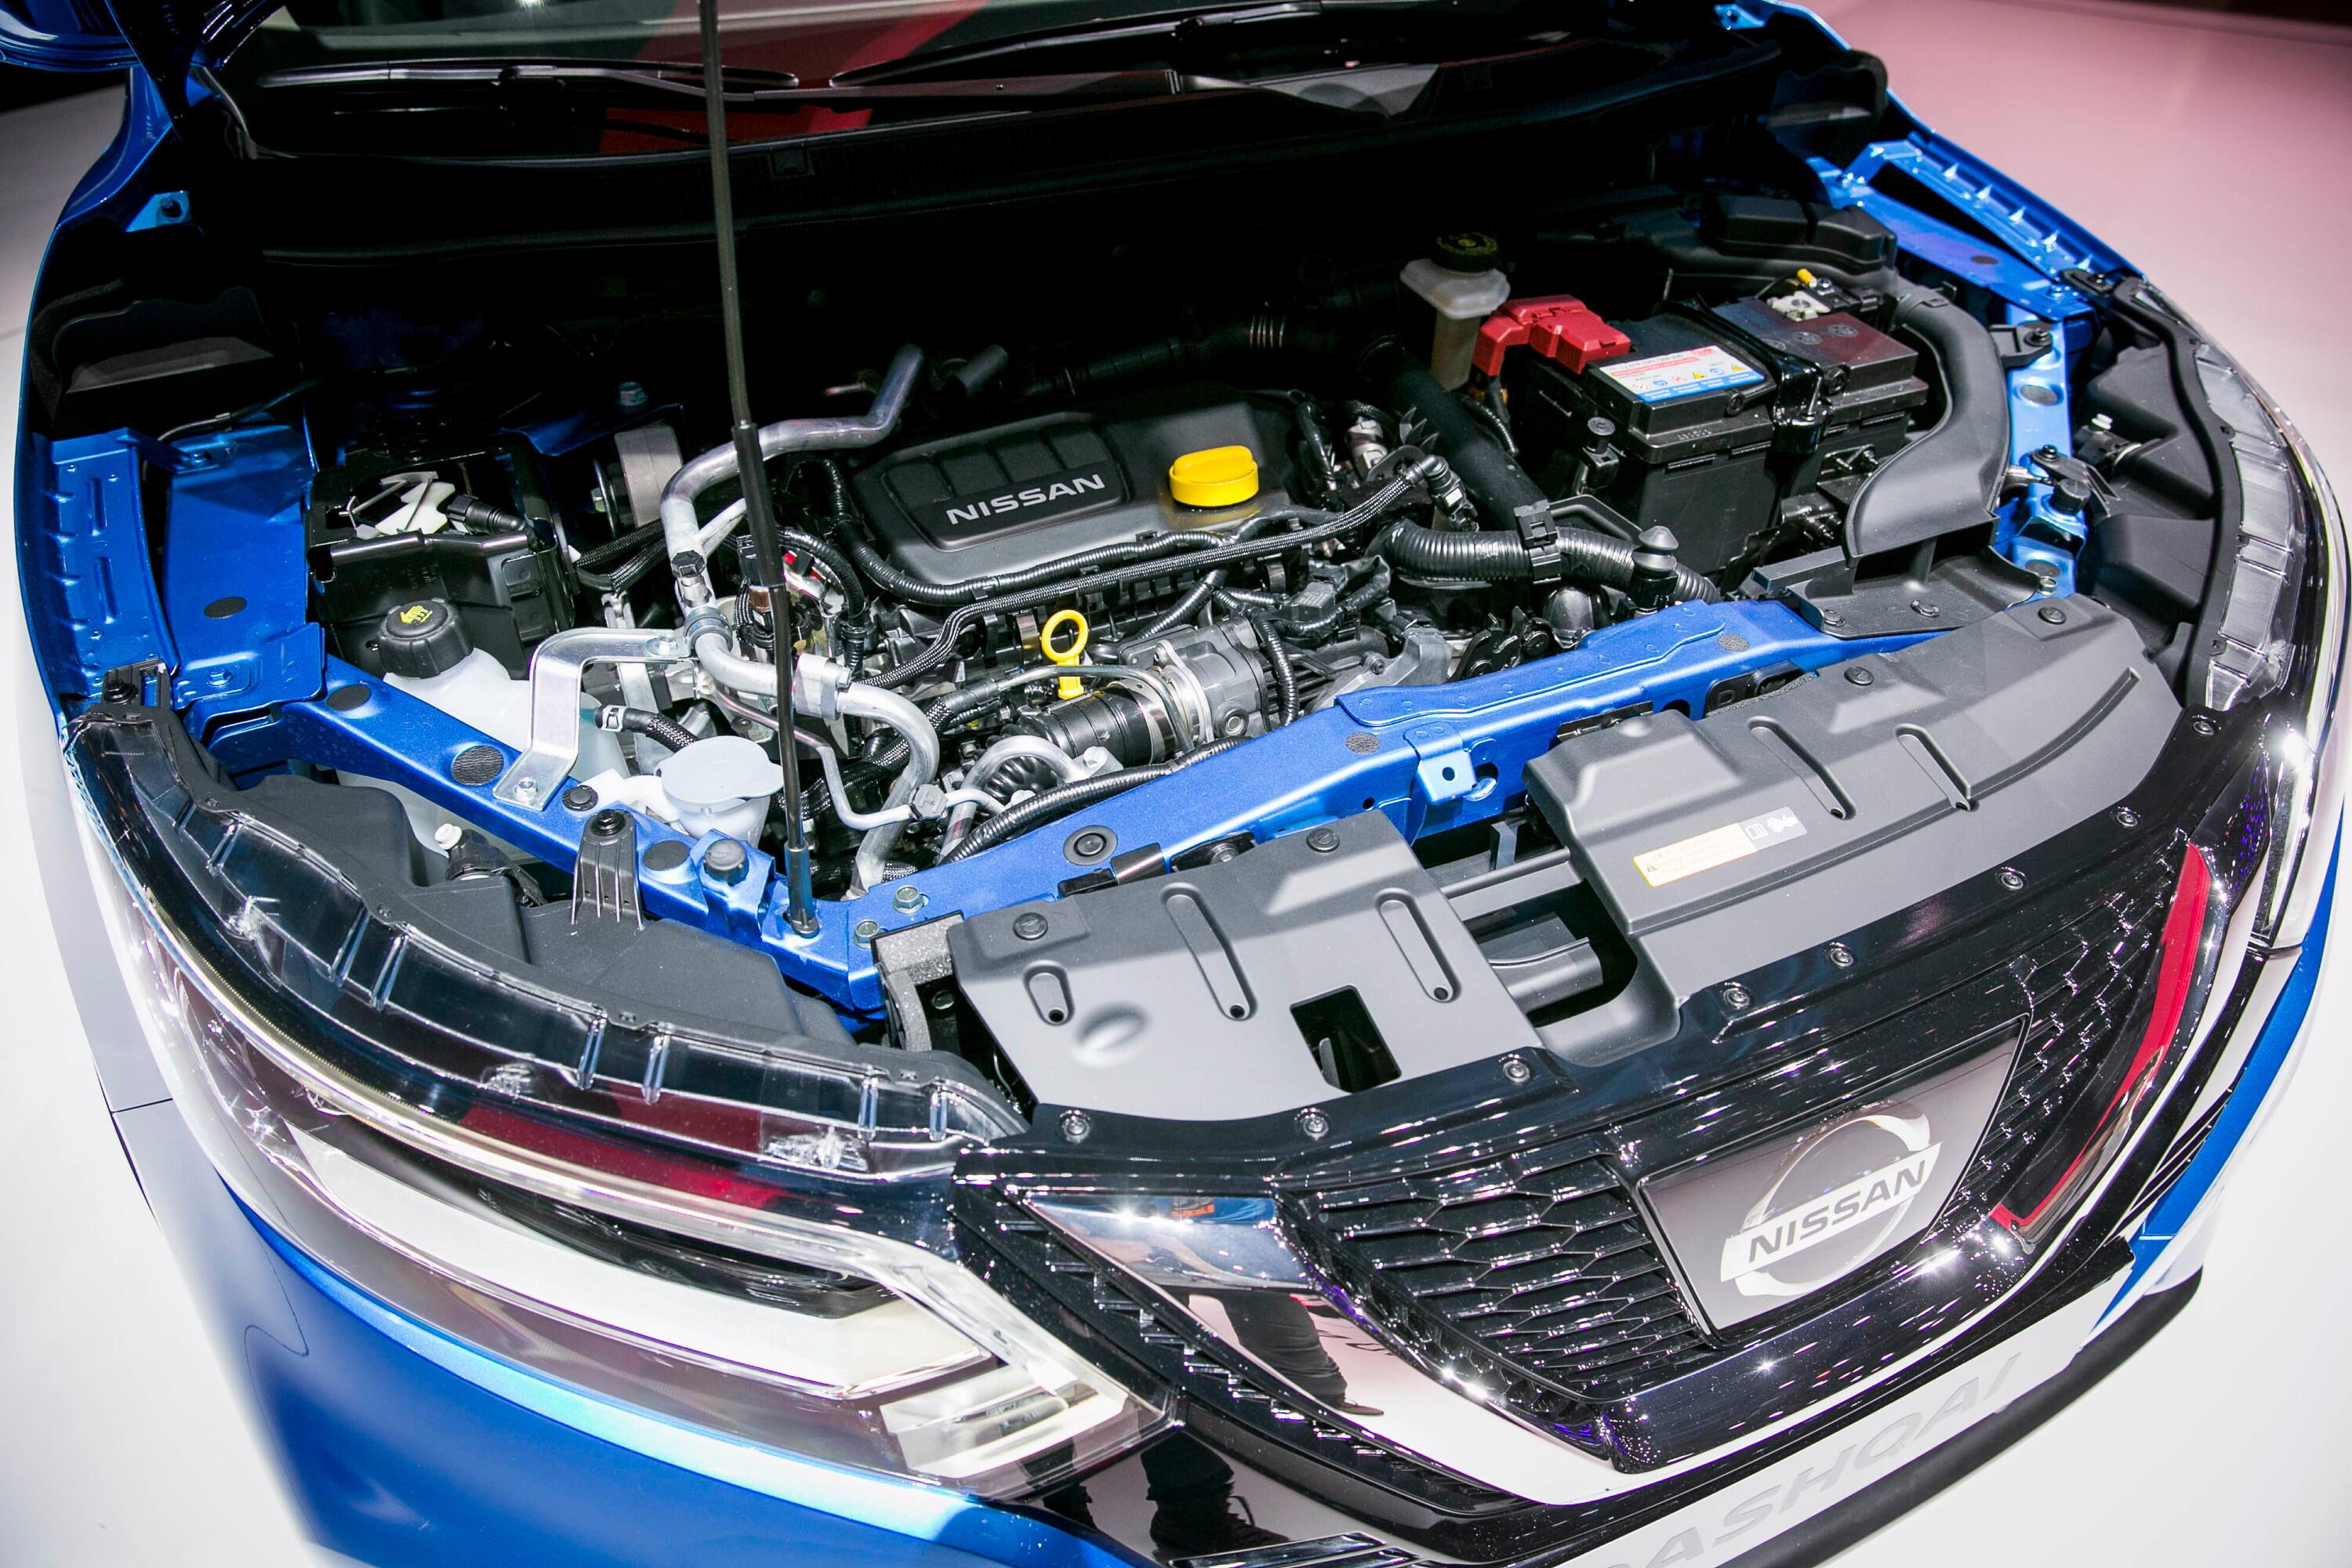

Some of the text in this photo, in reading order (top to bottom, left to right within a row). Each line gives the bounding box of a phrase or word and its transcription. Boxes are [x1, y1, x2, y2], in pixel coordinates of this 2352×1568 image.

[946, 474, 1105, 524] NISSAN
[1748, 1160, 1926, 1263] NISSAN
[1606, 1352, 2021, 1568] ASHQAI
